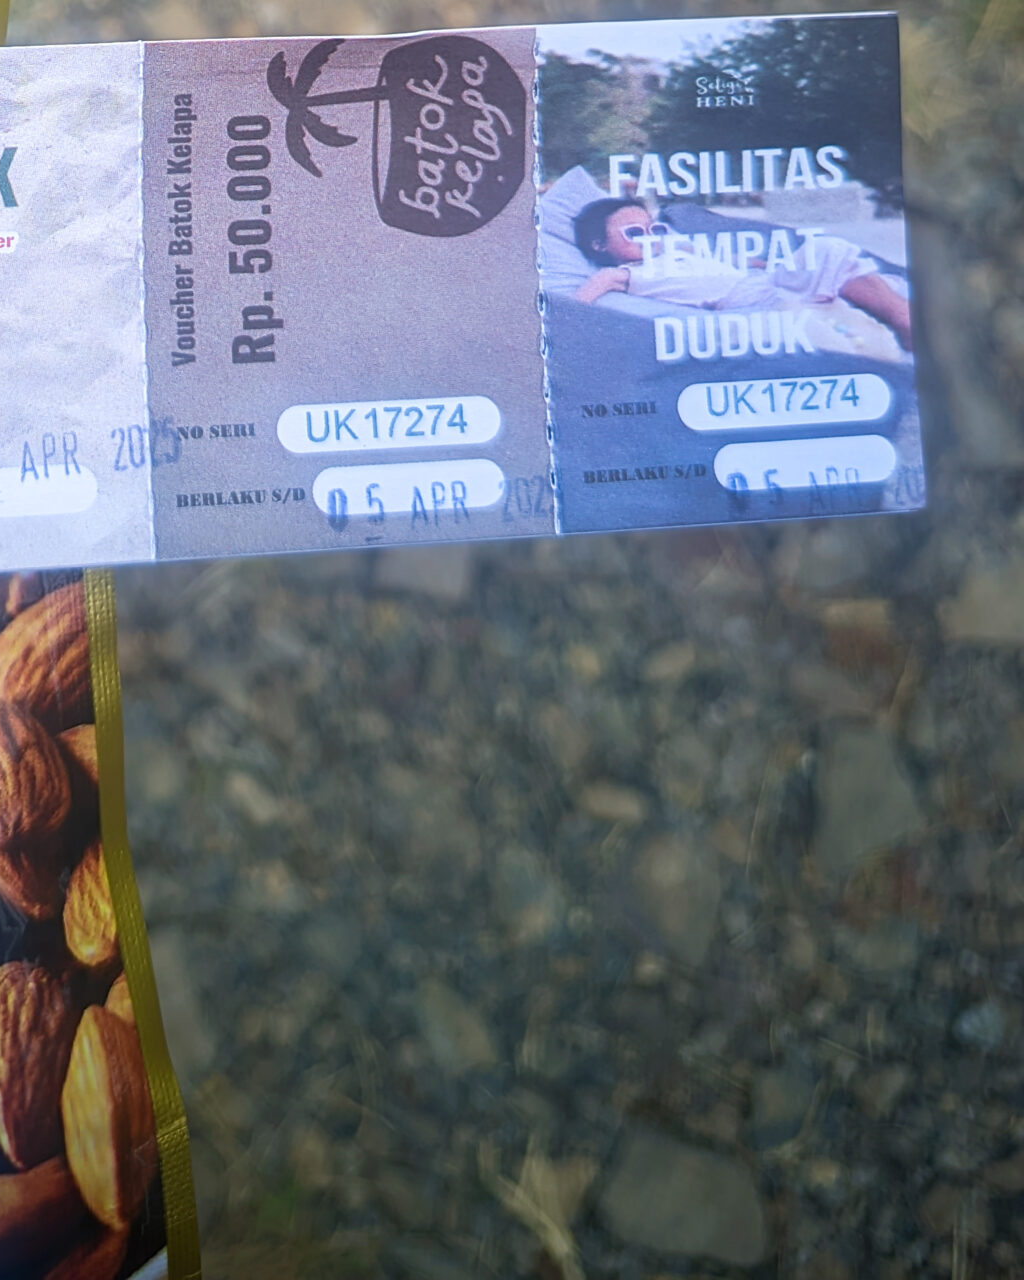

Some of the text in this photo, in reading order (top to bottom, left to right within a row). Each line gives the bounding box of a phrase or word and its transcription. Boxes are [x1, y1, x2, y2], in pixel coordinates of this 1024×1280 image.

[696, 95, 754, 108] HENI
[398, 54, 459, 220] batok
[608, 145, 846, 198] FASILITAS
[166, 92, 198, 367] Voucher Batok Kelapa
[226, 114, 284, 365] Rp. 50.000
[632, 228, 825, 279] TEMPAT
[653, 310, 816, 362] DUDUK
[177, 403, 469, 444] NO SERI UK17274
[581, 378, 861, 418] NO SERI UK17274
[20, 431, 81, 483] APR
[583, 465, 668, 484] BERLAKU
[674, 463, 707, 479] S/D
[176, 489, 267, 508] BERLAKU
[272, 487, 306, 505] S/D
[412, 480, 470, 530] APR
